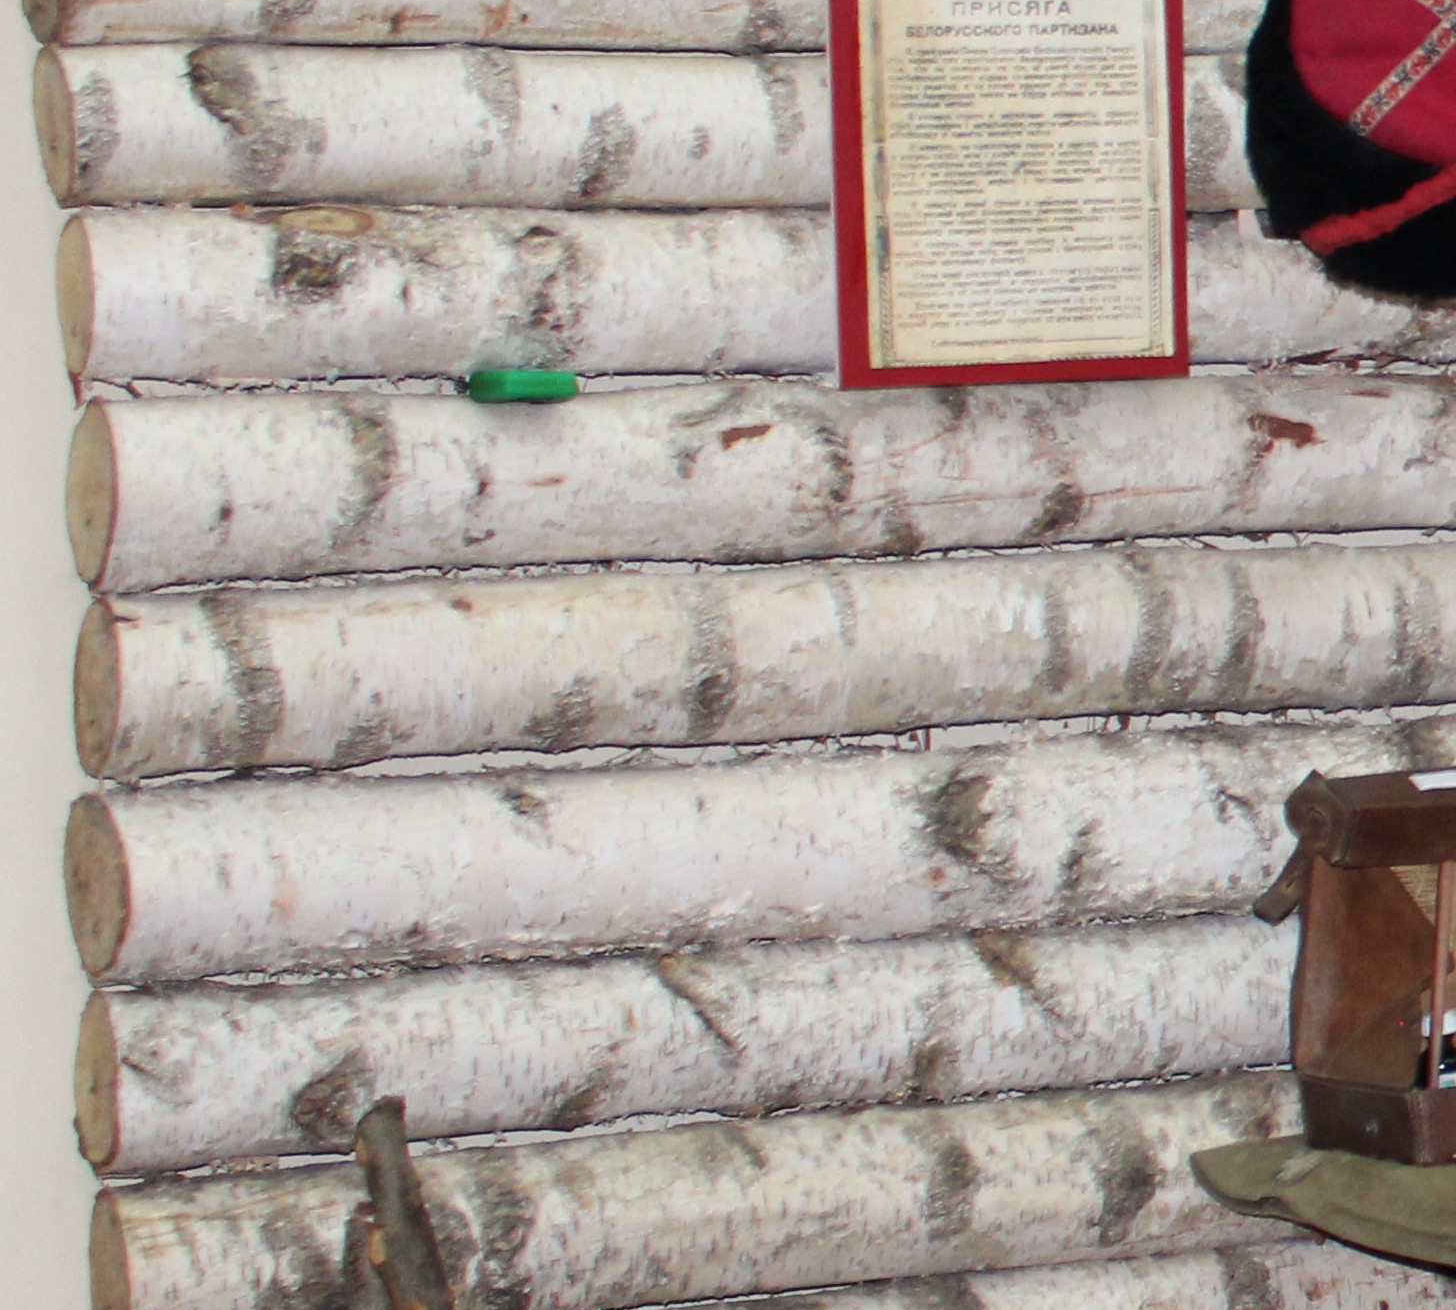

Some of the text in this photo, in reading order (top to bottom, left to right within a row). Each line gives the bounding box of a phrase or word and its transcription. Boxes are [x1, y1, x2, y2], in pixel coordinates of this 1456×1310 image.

[951, 0, 1072, 17] ПРИСЯГА
[905, 23, 1119, 38] БЕЛОРУССКОГО ПАРТИЗАНА
